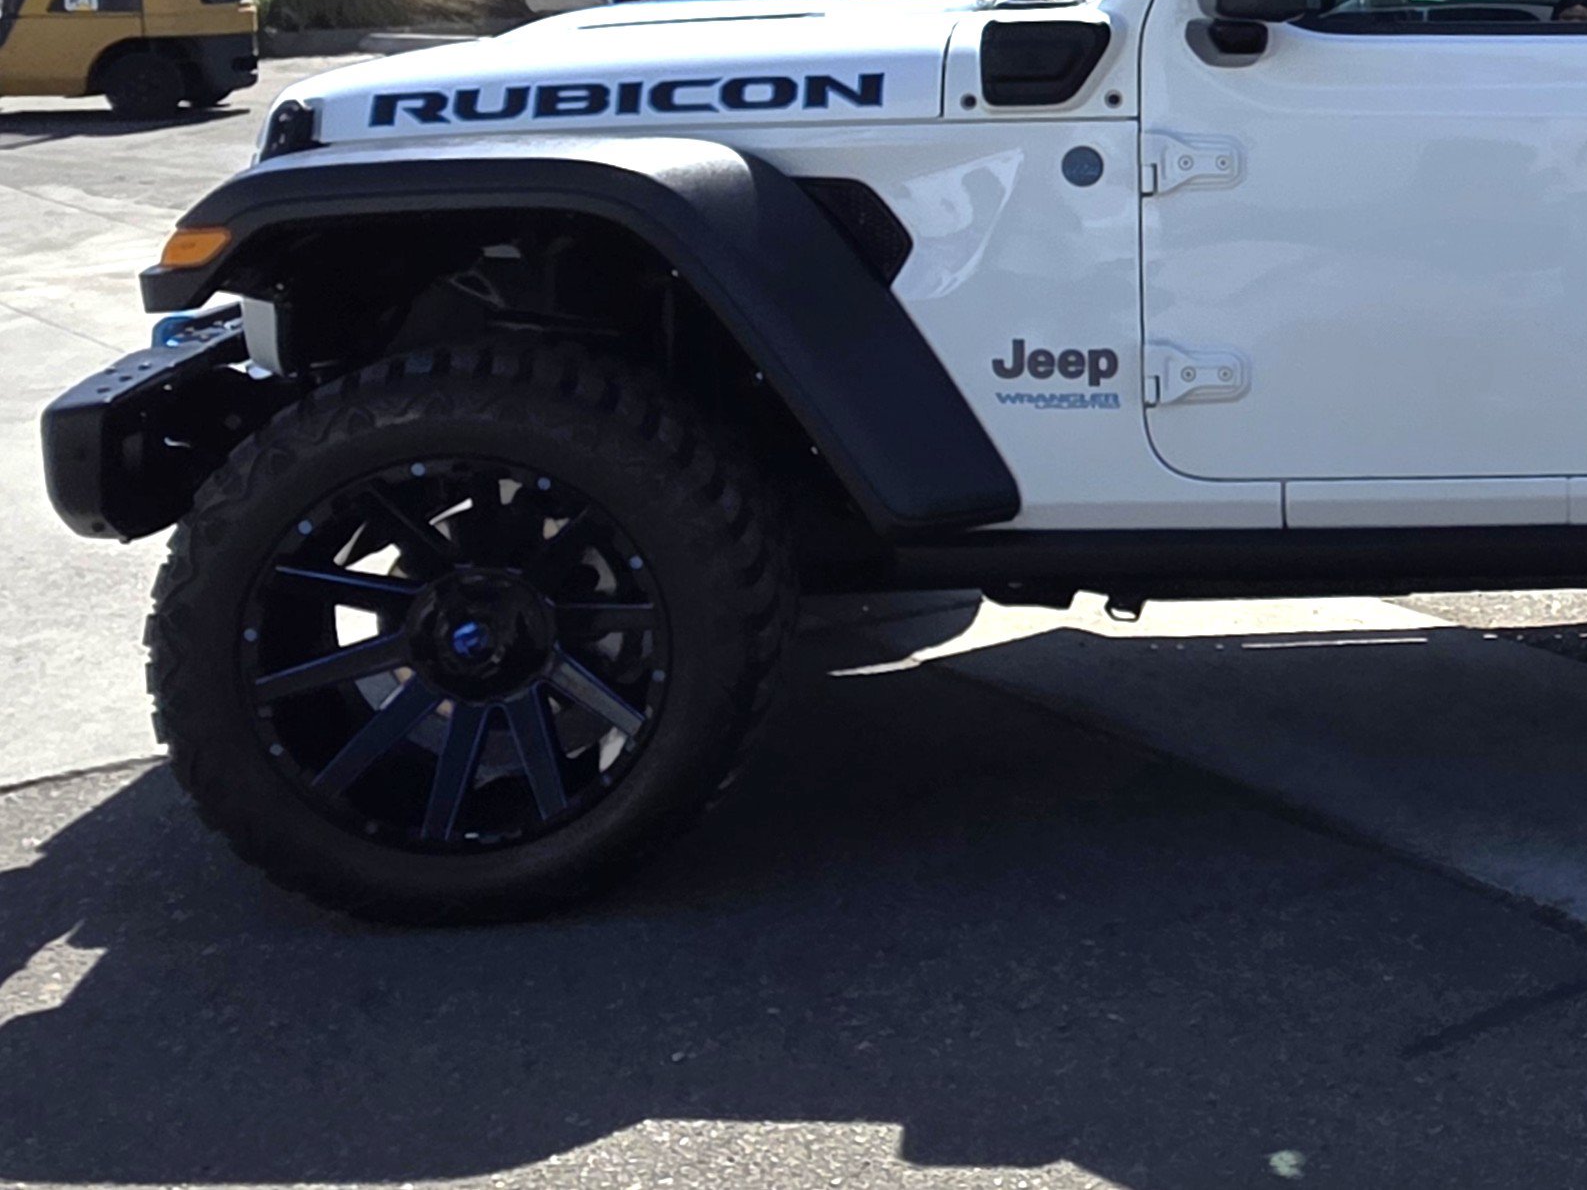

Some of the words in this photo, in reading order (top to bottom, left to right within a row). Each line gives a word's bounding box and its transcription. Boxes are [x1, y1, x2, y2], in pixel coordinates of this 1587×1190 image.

[368, 72, 885, 128] RUBICON
[992, 338, 1118, 387] Jeep
[996, 393, 1119, 406] WRANGLER
